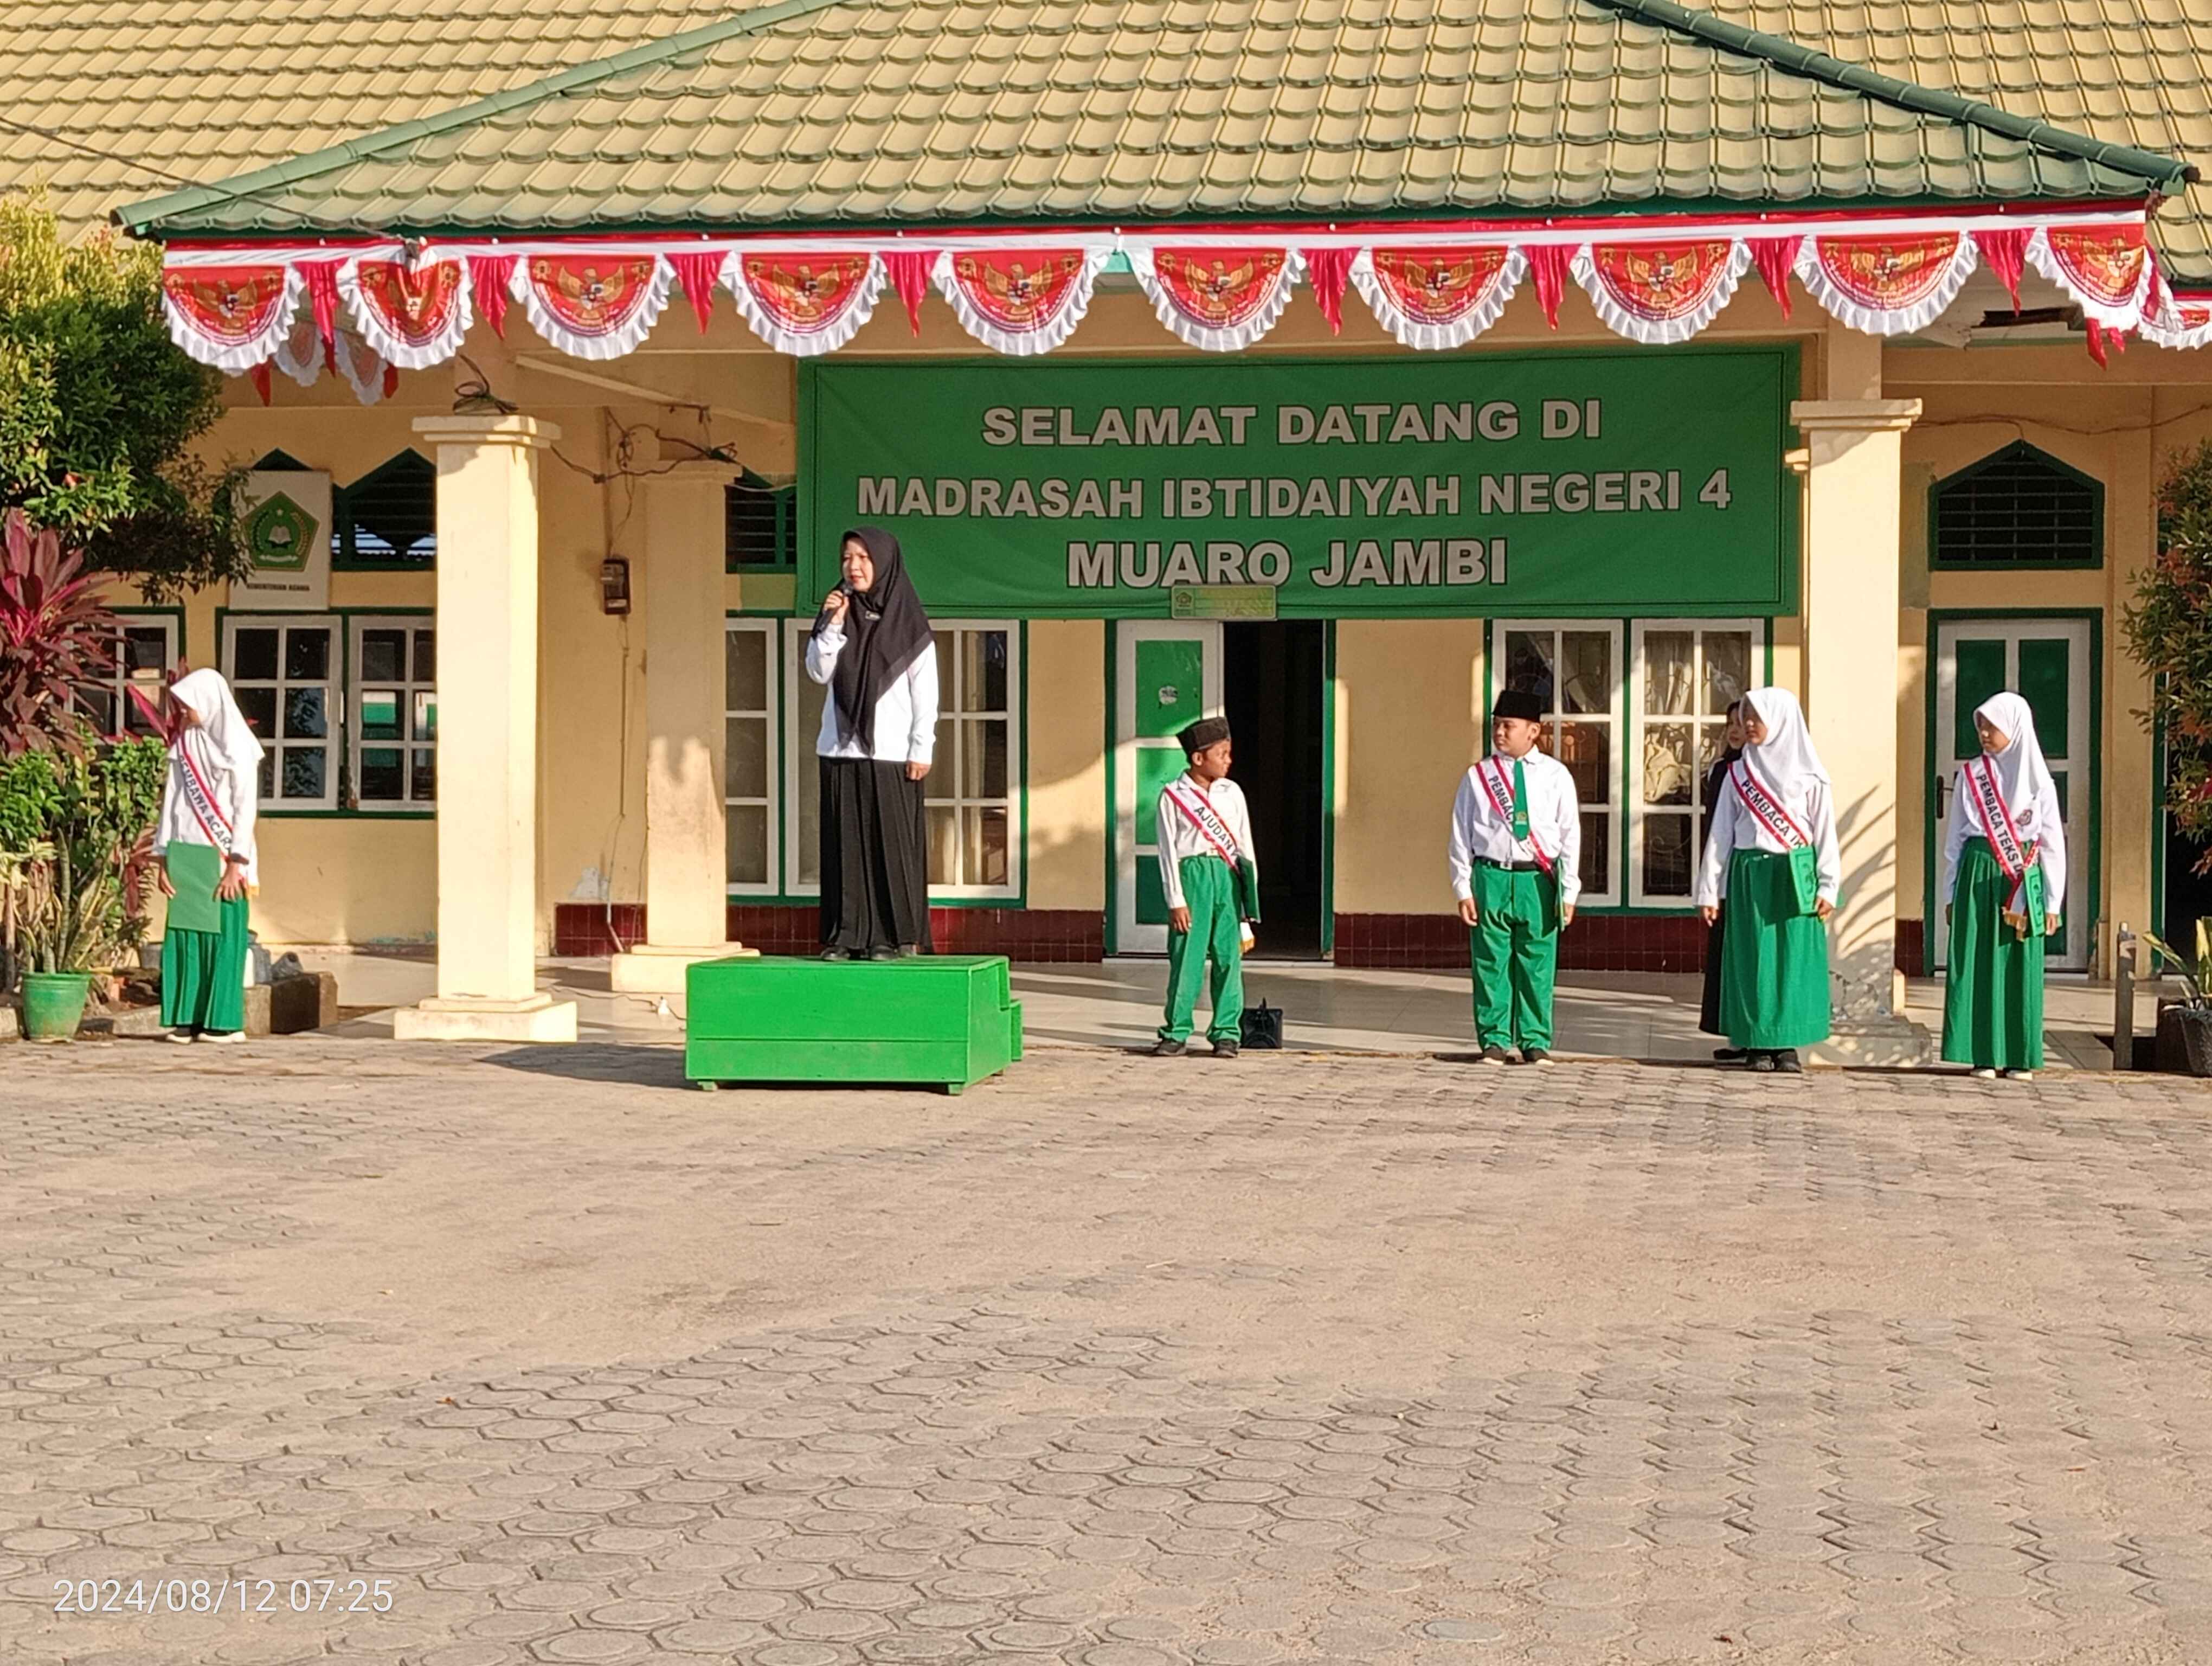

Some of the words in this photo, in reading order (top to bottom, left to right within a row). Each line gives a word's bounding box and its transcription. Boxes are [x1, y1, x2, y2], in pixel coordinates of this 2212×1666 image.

[983, 406, 1257, 446] SELAMAT
[1278, 401, 1519, 444] DATANG
[1542, 400, 1600, 439] DI
[857, 478, 1143, 518] MADRASAH
[1162, 475, 1459, 517] IBTIDAIYAH
[1480, 470, 1680, 513] NEGERI
[1699, 469, 1731, 508] 4
[1068, 541, 1291, 588] MUARO
[1310, 539, 1506, 586] JAMBI
[1488, 775, 1513, 825] PEMBAC
[1741, 779, 1790, 837] PEMBACA
[1976, 773, 2004, 831] PEMBACA
[1997, 829, 2019, 863] TEKS
[1194, 806, 1233, 850] AJUDAN
